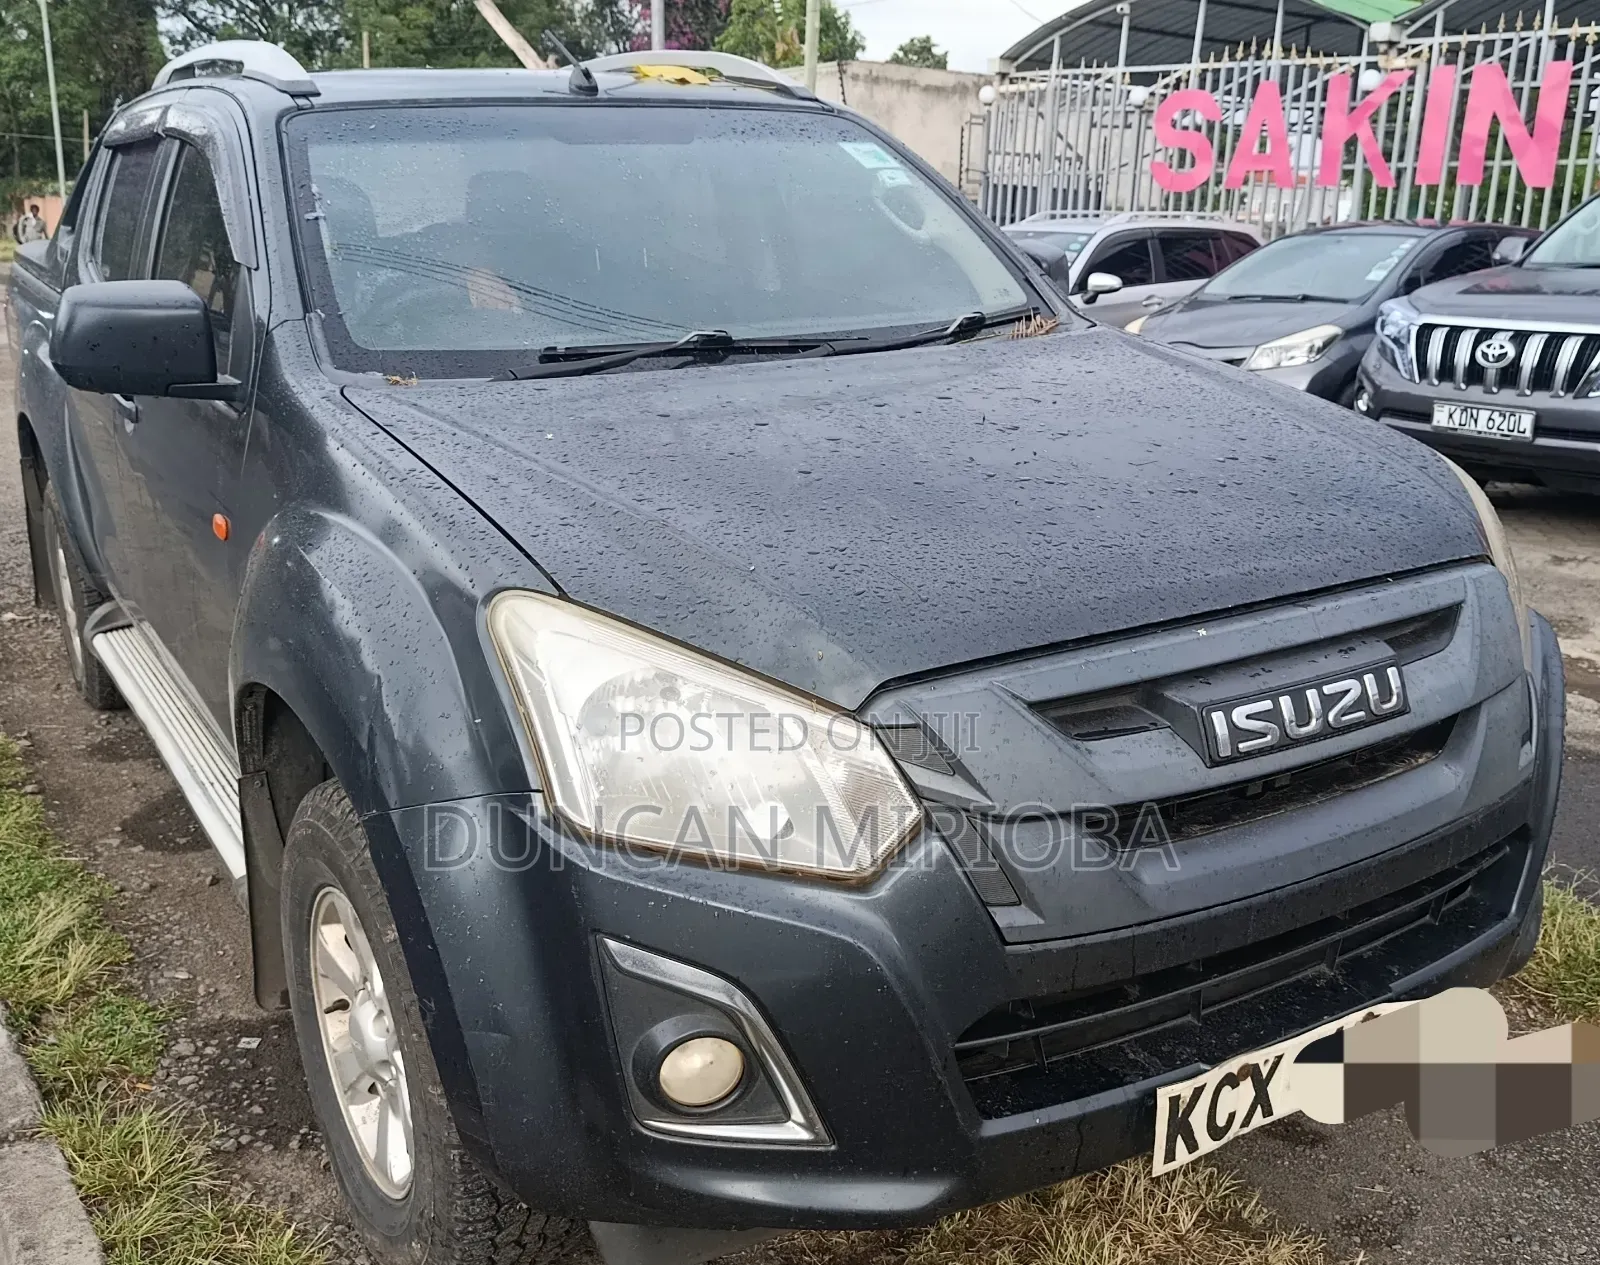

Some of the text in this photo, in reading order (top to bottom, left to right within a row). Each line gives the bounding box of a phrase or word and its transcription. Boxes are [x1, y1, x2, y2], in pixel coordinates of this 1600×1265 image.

[1150, 60, 1573, 193] SAKIN
[1446, 406, 1480, 429] KDN
[1485, 411, 1527, 435] 620L
[1211, 666, 1402, 758] ISUZU
[1163, 1052, 1285, 1165] KCX
